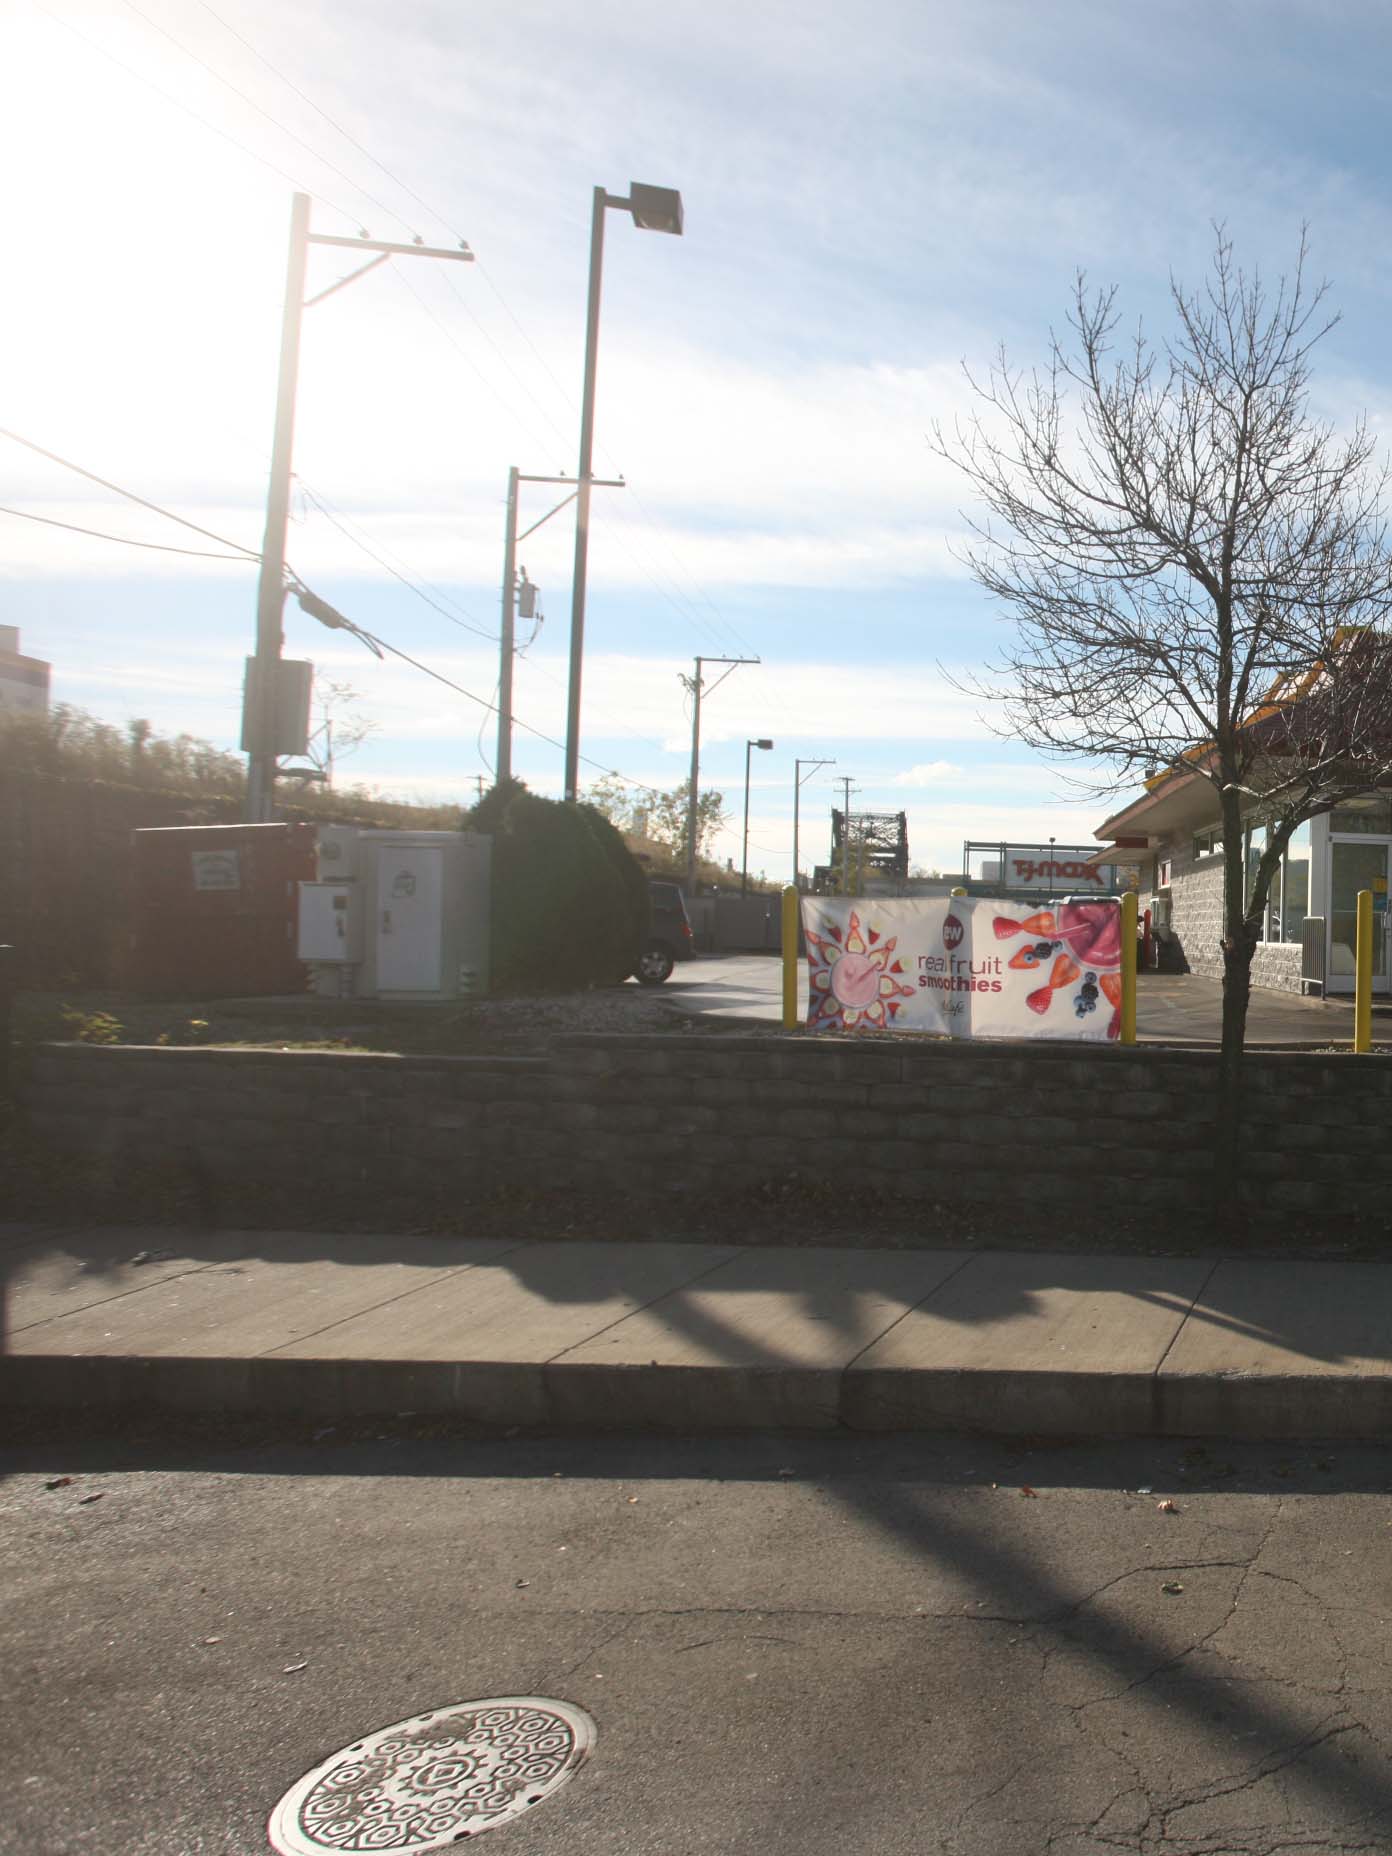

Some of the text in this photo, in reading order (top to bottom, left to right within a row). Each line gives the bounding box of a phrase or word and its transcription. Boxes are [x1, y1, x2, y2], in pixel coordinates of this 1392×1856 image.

[943, 926, 962, 941] ew
[949, 954, 1003, 975] fruit
[918, 974, 1003, 993] smoothies
